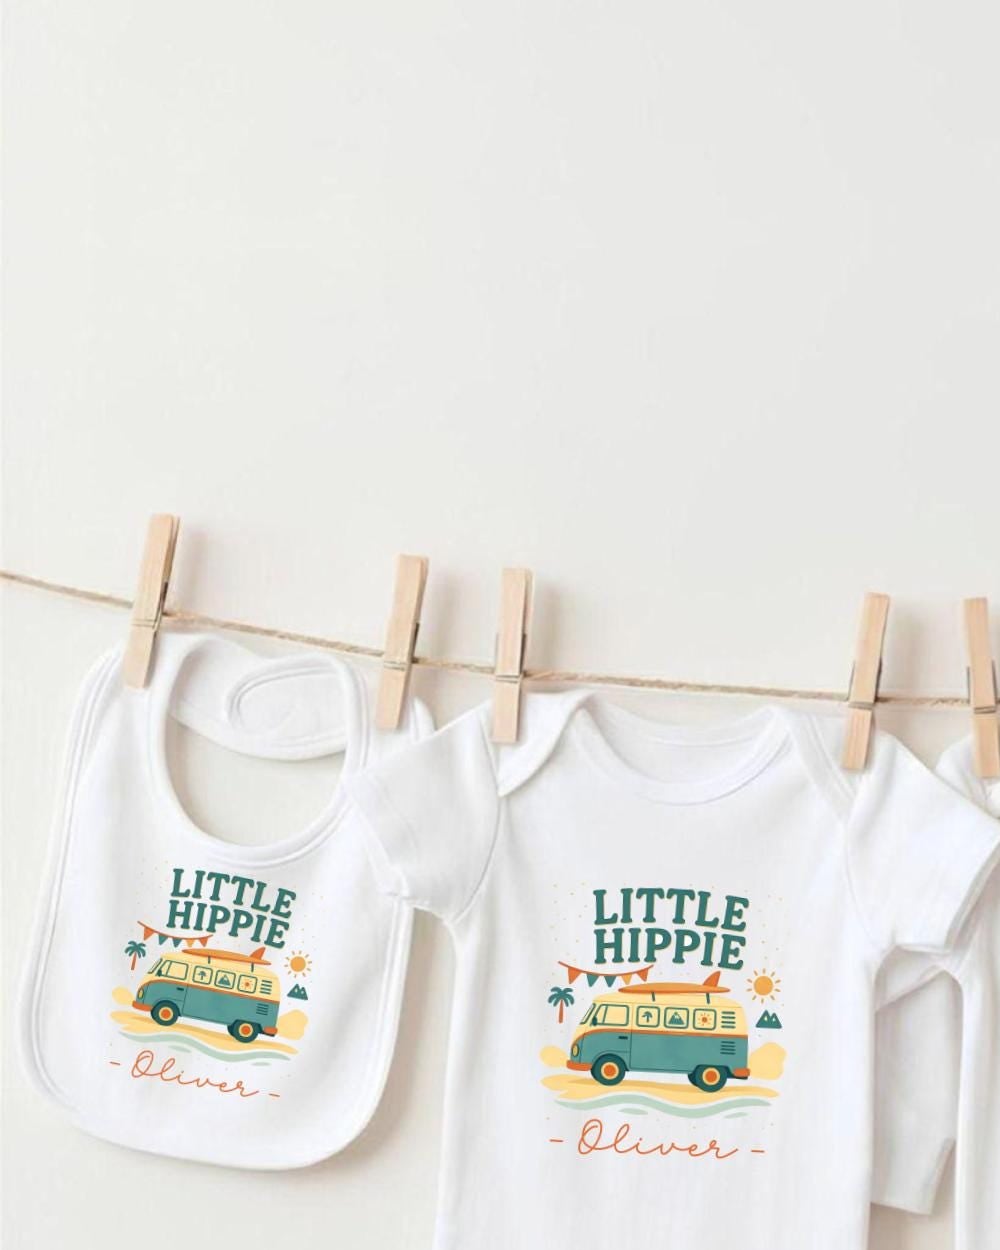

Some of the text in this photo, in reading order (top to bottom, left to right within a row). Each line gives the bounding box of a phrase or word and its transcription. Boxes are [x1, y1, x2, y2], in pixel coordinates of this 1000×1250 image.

[170, 868, 297, 919] LITTLE
[593, 887, 749, 932] LITTLE
[166, 900, 289, 949] HIPPIE
[594, 927, 747, 970] HIPPIE
[131, 1050, 259, 1097] Oliver
[578, 1118, 738, 1159] Oliver
